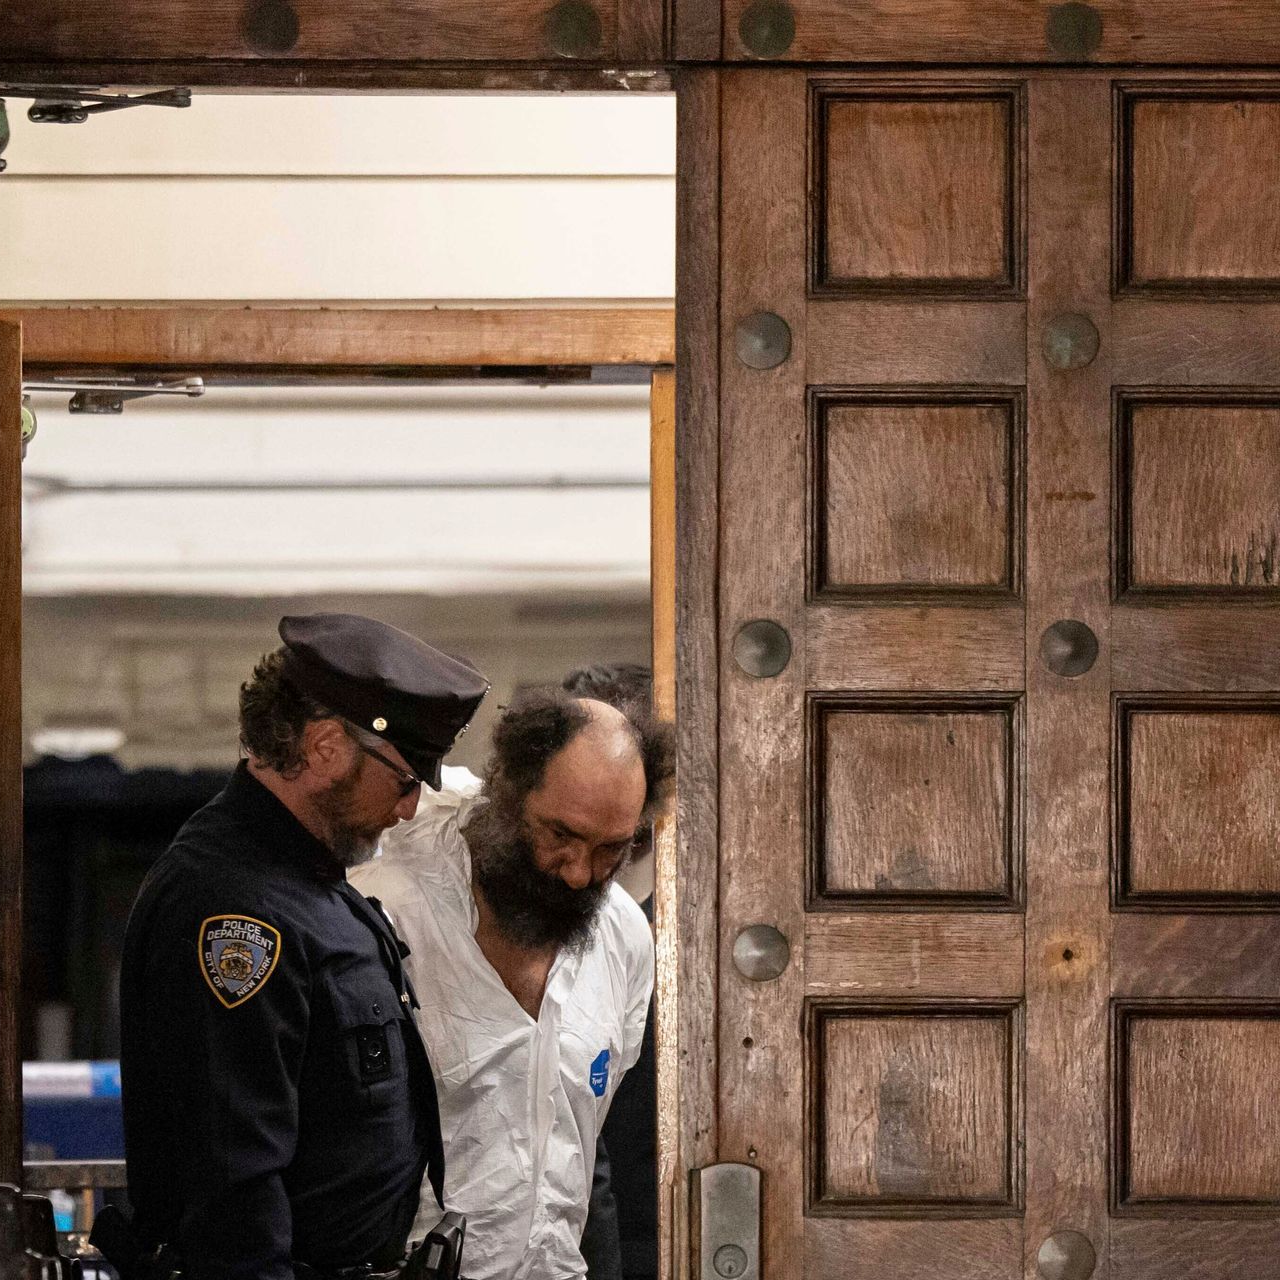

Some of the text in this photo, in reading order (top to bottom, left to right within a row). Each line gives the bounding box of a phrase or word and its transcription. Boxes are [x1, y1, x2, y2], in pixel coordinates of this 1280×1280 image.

[207, 929, 274, 951] DEPARTMENT
[222, 920, 262, 936] POLICE
[205, 951, 224, 990] CITY OF
[236, 955, 272, 997] NEW YORK
